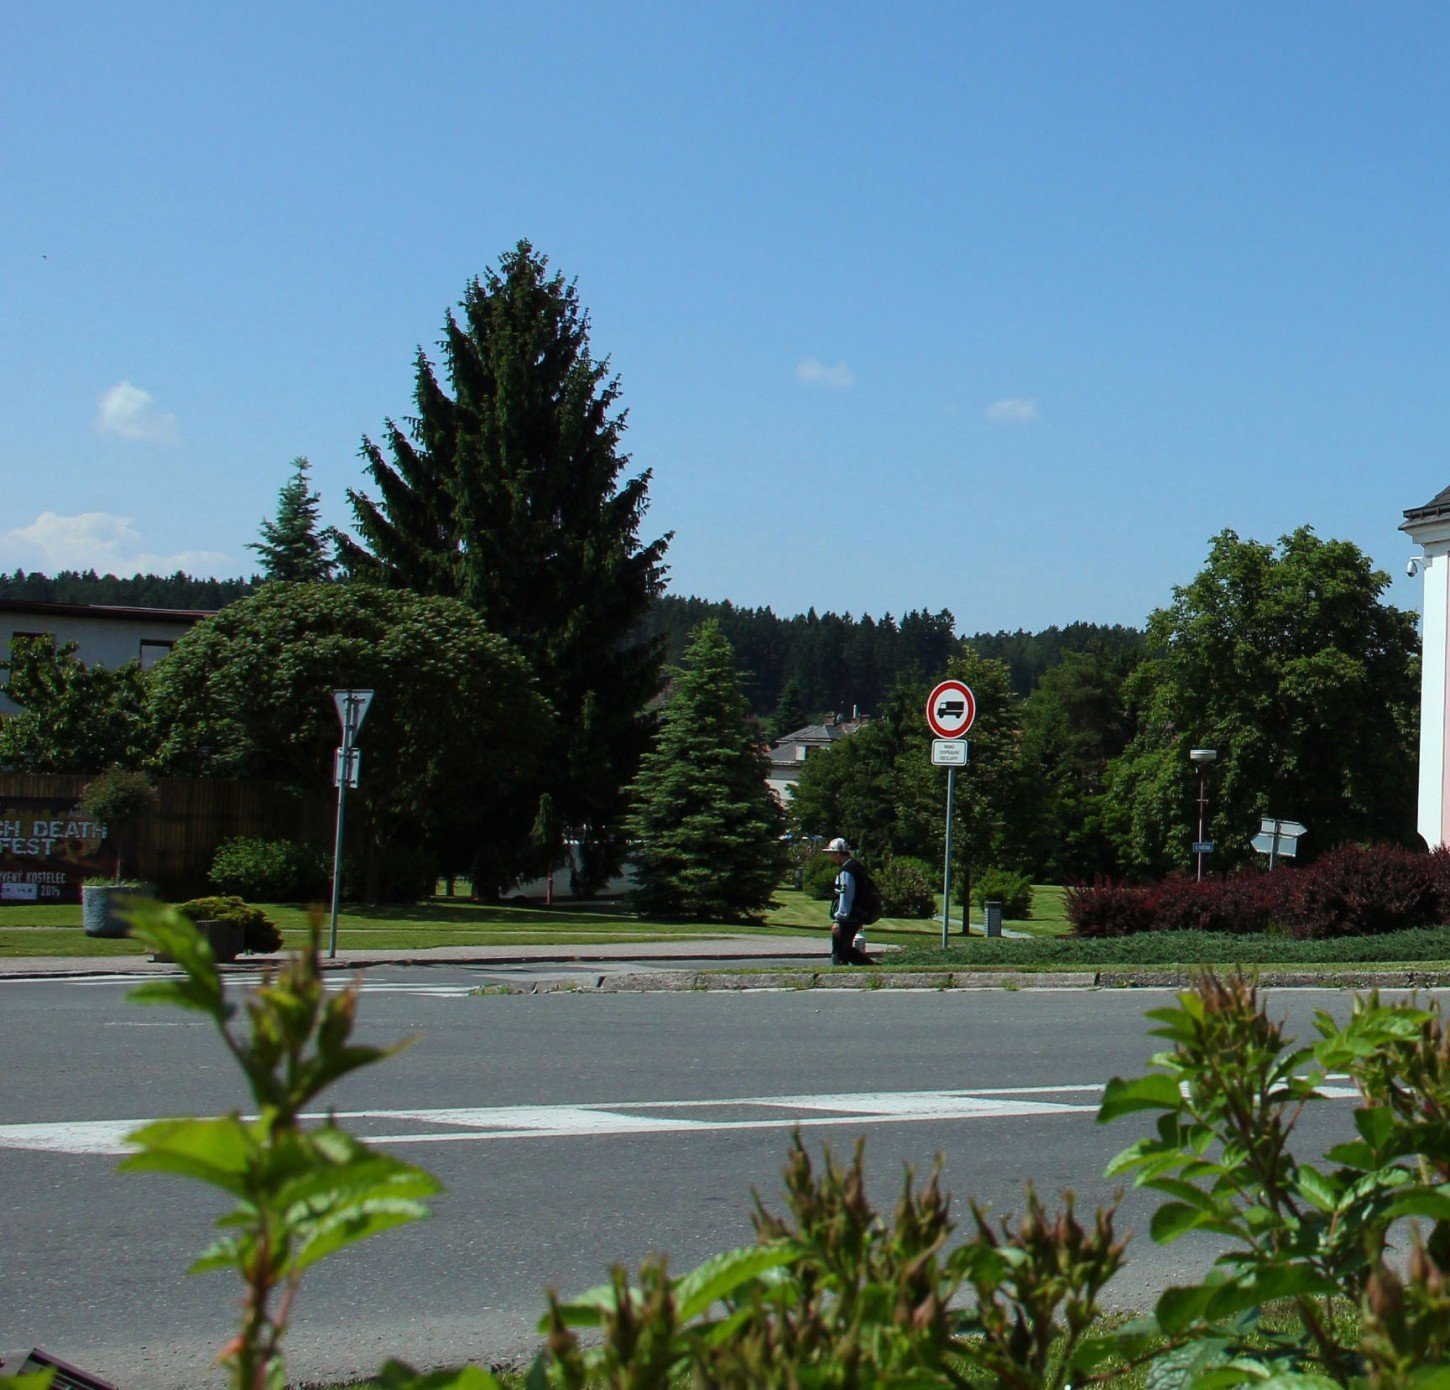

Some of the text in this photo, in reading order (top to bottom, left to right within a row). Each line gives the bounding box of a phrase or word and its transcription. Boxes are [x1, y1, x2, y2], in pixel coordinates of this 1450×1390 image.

[33, 821, 107, 838] DEATH
[0, 838, 56, 855] FEST
[26, 872, 66, 884] KOSTELEC
